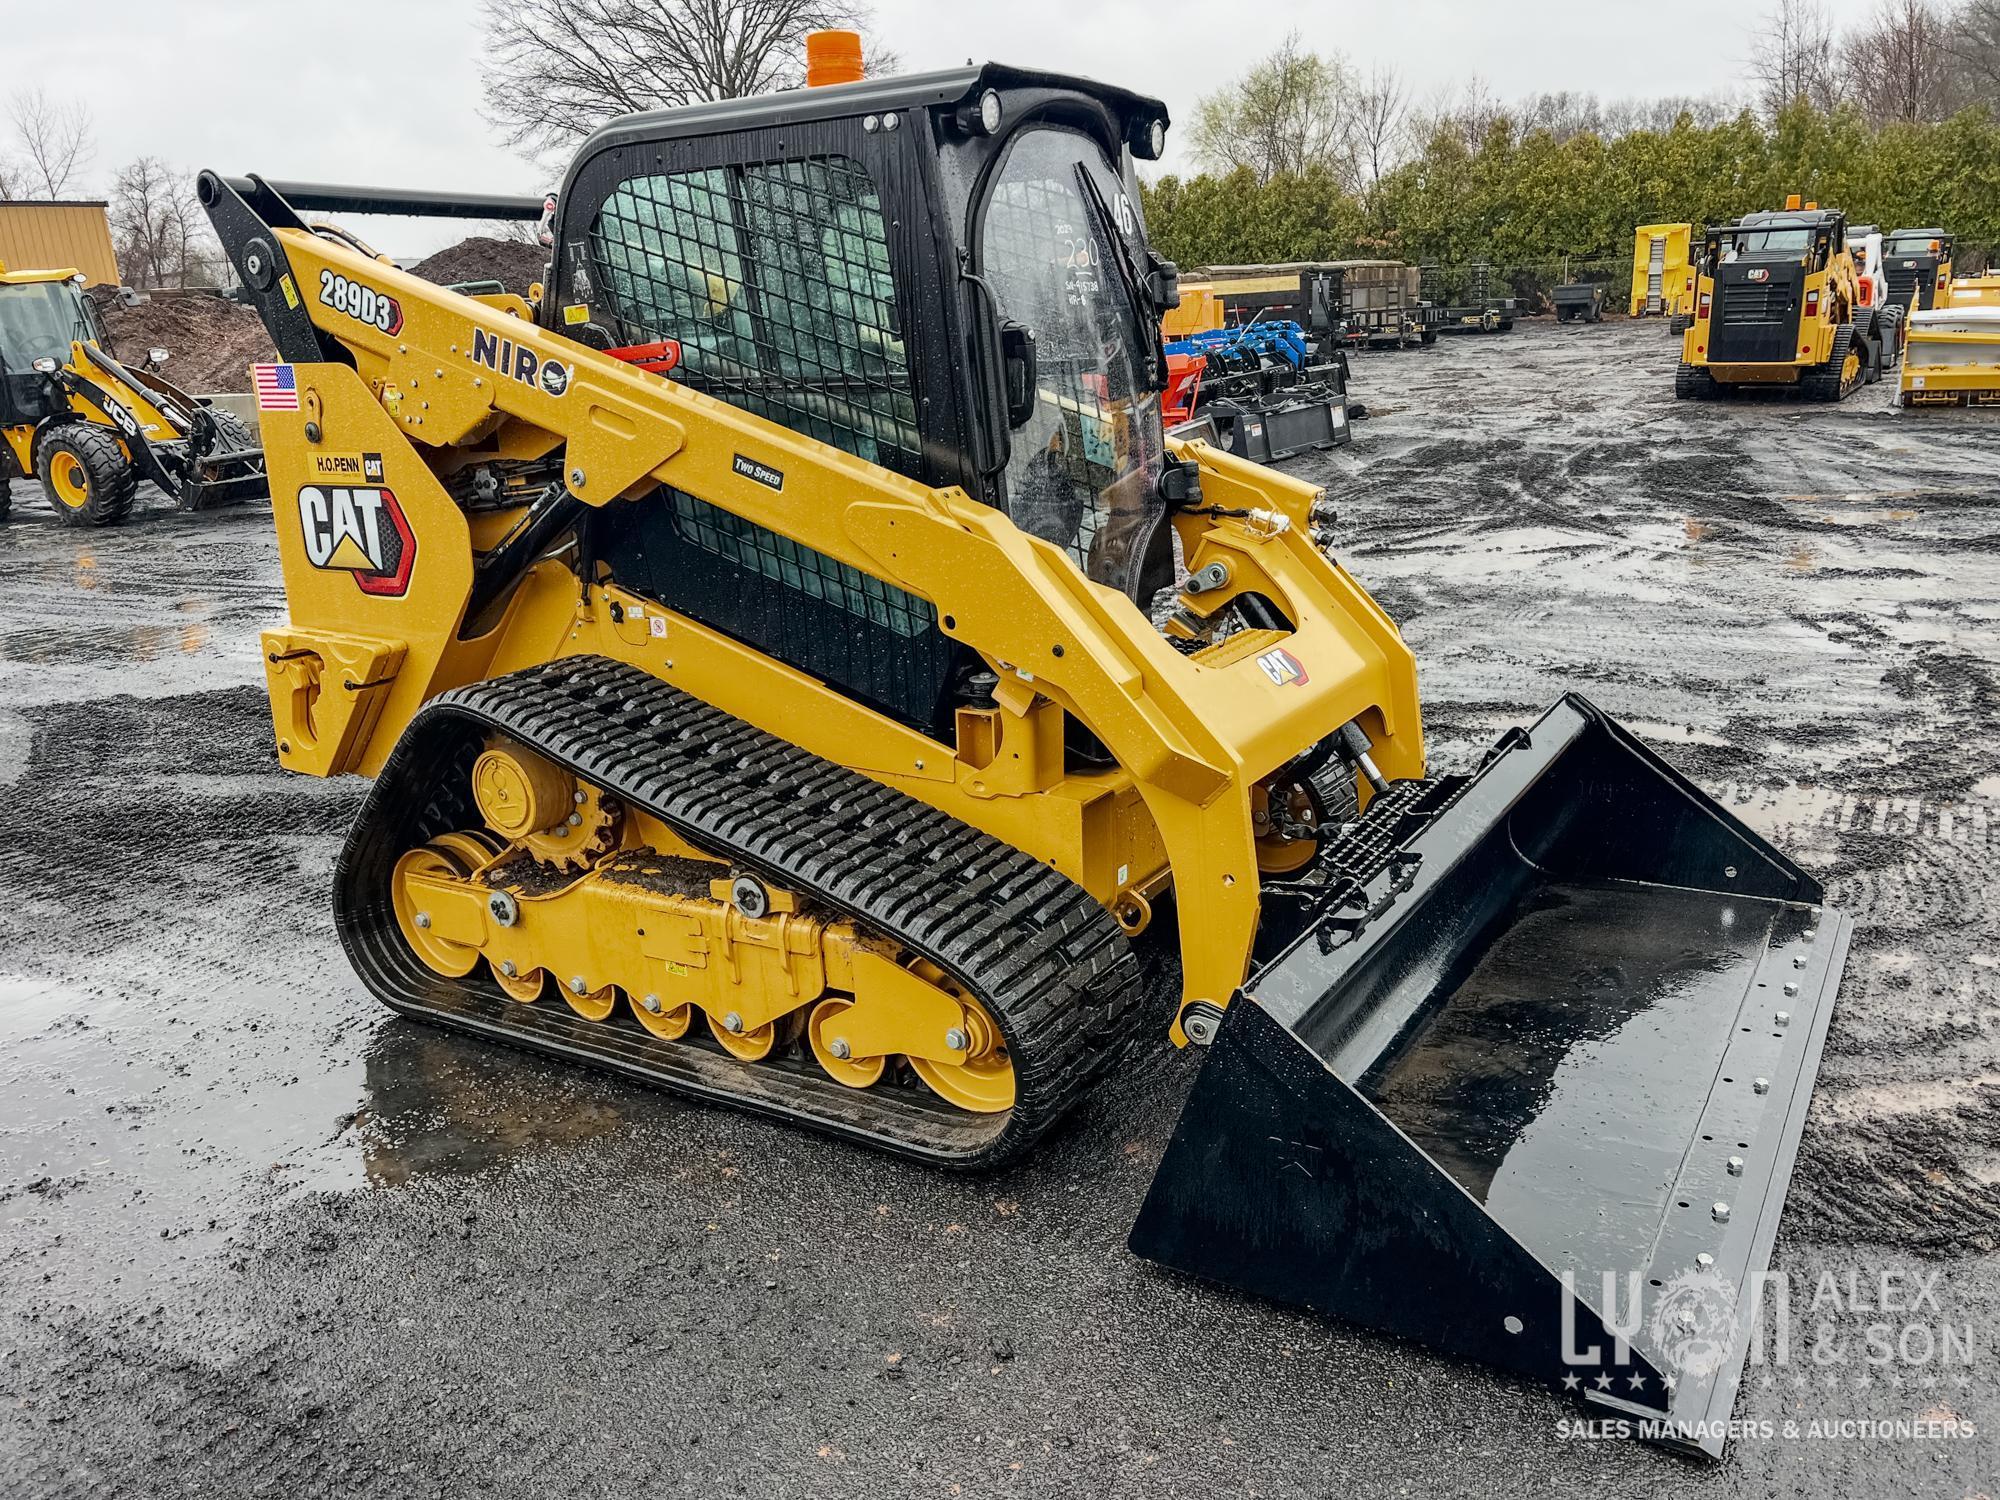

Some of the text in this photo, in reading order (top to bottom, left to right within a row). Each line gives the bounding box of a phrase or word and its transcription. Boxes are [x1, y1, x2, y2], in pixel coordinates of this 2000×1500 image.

[1113, 192, 1132, 235] 46
[1064, 237, 1099, 269] 230
[1747, 268, 1765, 280] CAT
[319, 268, 391, 332] 289D3
[471, 325, 569, 398] NIRO
[103, 395, 136, 436] JCB
[364, 459, 382, 477] CAT
[299, 486, 383, 570] CAT
[1256, 648, 1299, 686] CAT
